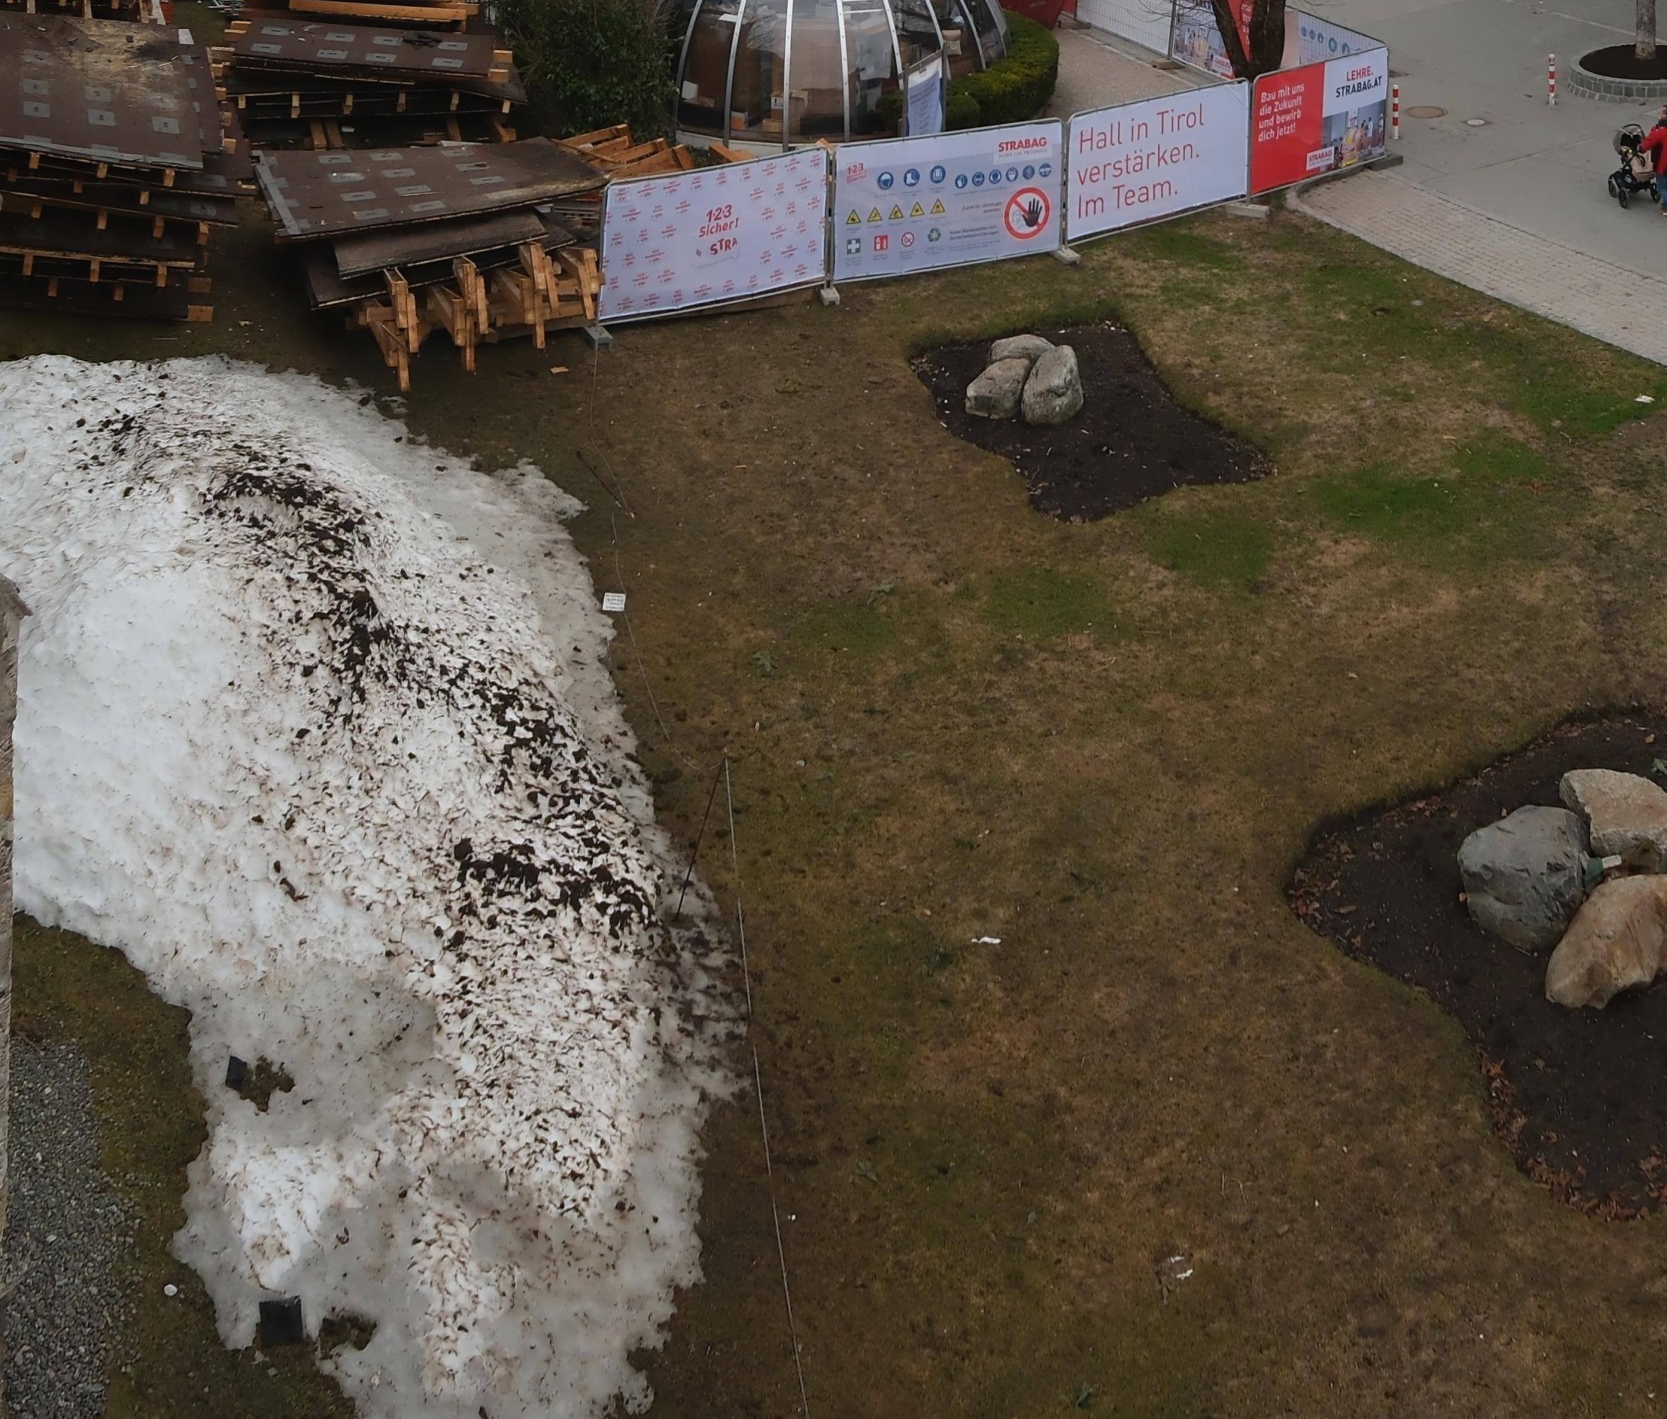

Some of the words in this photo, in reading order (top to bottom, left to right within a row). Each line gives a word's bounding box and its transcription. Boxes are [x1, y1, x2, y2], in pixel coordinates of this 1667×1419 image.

[1346, 66, 1374, 82] LEHRE.
[1261, 92, 1276, 103] Bau
[1278, 85, 1291, 98] mit
[1291, 83, 1305, 94] uns
[1335, 76, 1383, 98] STRABAG.AT
[1260, 104, 1272, 116] die
[1273, 95, 1303, 112] Zukunft
[1078, 121, 1123, 154] Hall
[1130, 117, 1149, 142] in
[1156, 103, 1205, 135] Tirol
[1259, 117, 1274, 129] und
[1276, 109, 1302, 124] bewirb
[1258, 130, 1275, 142] dich
[1275, 122, 1296, 140] jetzt!
[998, 136, 1048, 153] STRABAG
[1077, 143, 1200, 186] verstärken.
[1078, 194, 1104, 219] Im
[1112, 180, 1178, 210] Team.
[698, 217, 739, 238] Sicher!
